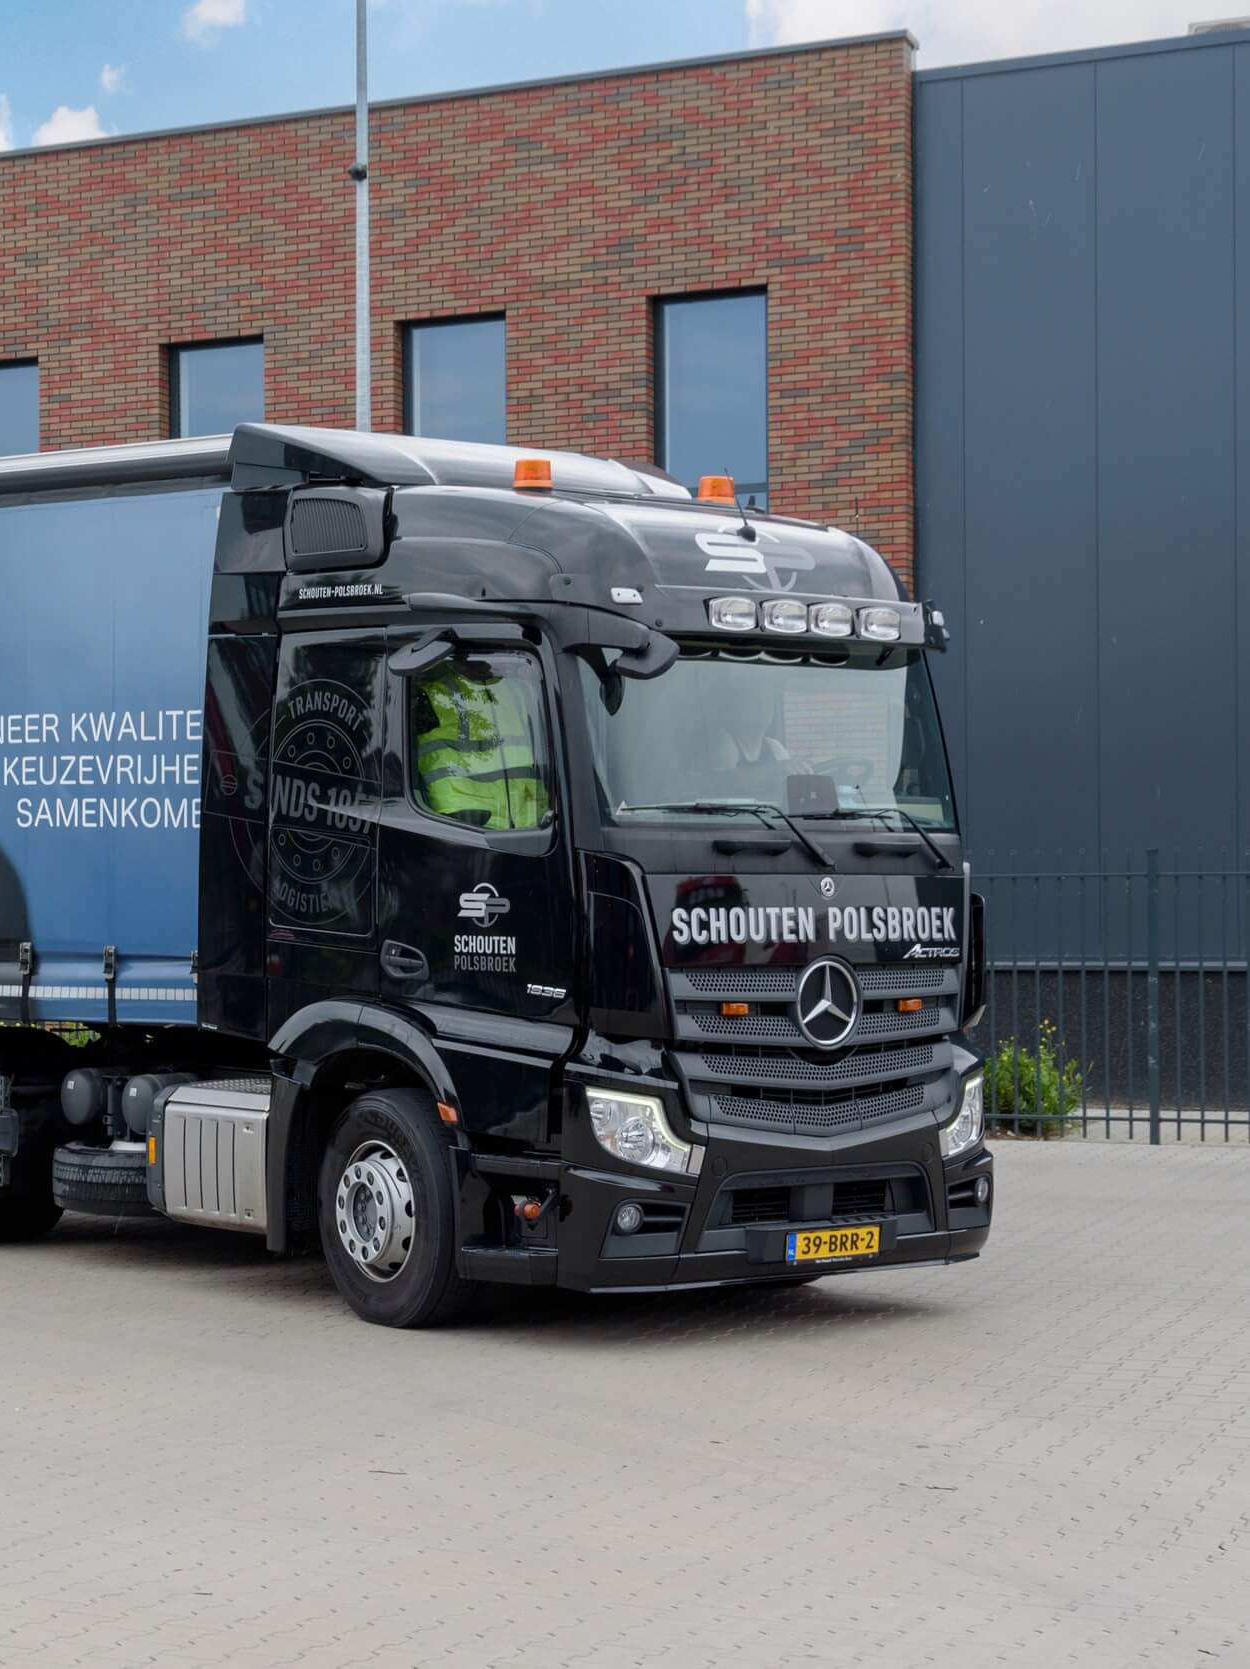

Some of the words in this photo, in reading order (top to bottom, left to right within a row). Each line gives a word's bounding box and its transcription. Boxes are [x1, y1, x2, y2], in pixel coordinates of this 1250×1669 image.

[298, 583, 384, 600] SCHOUTEN-POLSBROEK.NL
[71, 709, 202, 742] KWALITE
[287, 691, 364, 732] TRANSPORT
[3, 754, 200, 786] KEUZEVRIJHE
[244, 770, 321, 822] SNDS
[16, 798, 201, 828] SAMENKOME
[271, 876, 343, 914] OGISTIE
[672, 906, 816, 944] SCHOUTEN
[828, 905, 957, 942] POLSBROEK
[454, 934, 516, 955] SCHOUTEN
[454, 955, 517, 973] POLSBROEK
[801, 1231, 875, 1255] 39-BRR-2
